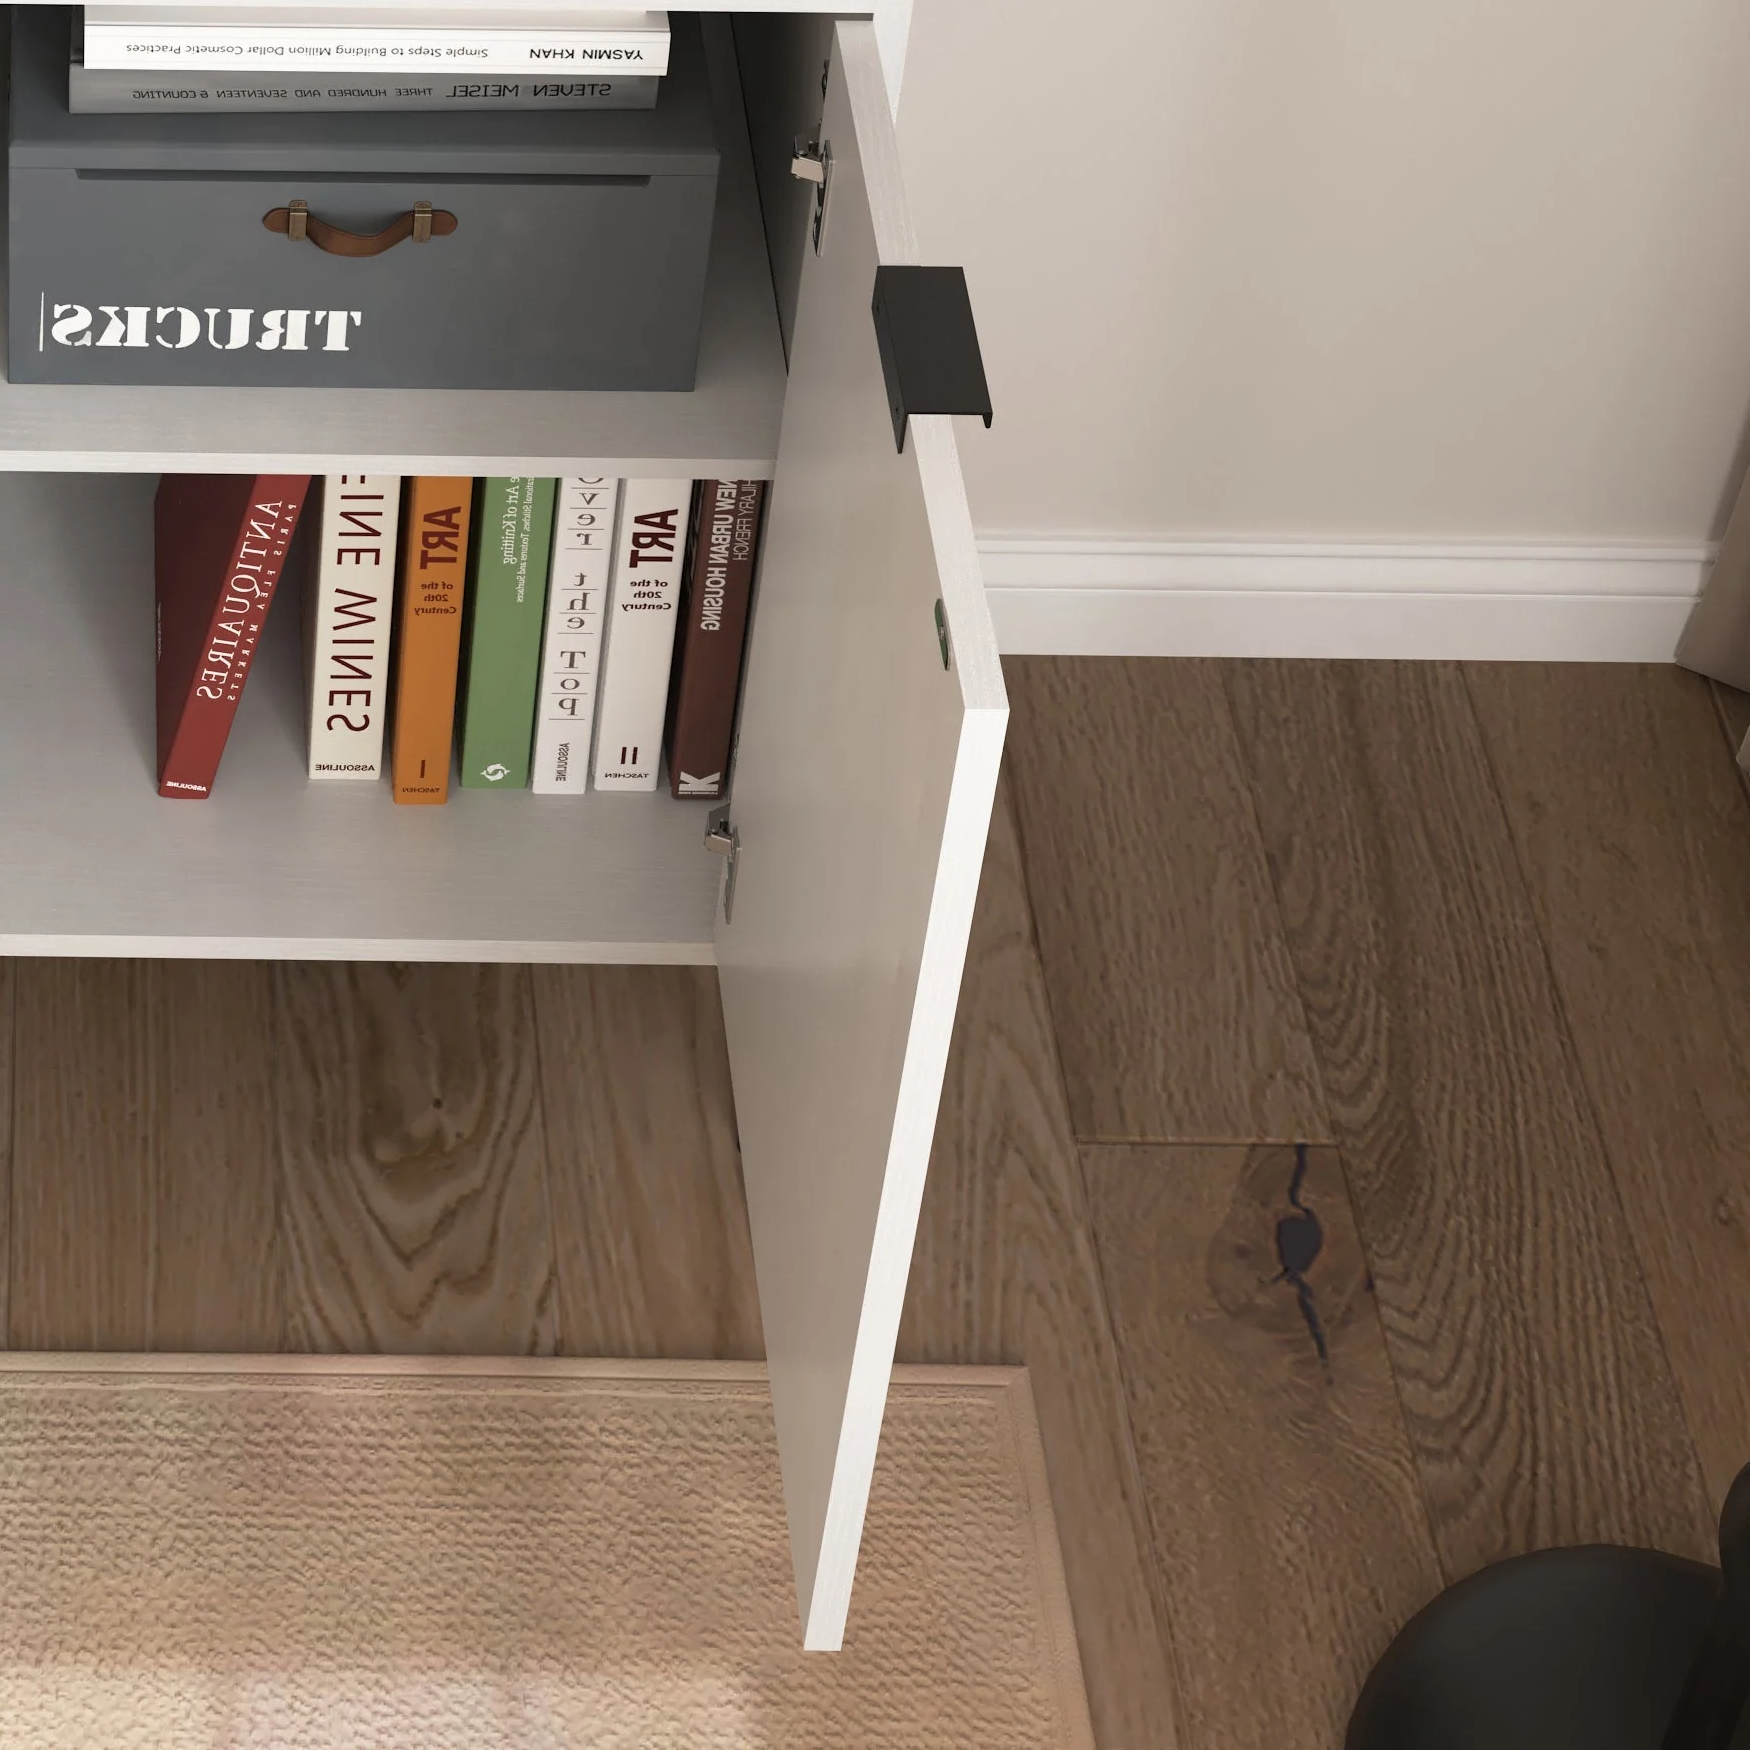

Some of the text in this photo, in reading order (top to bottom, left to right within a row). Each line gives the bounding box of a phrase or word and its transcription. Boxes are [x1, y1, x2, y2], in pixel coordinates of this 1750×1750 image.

[126, 44, 489, 58] Simple Steps to Building Million Dollar Cosmetic Practices
[529, 48, 644, 60] YASMIN KHAN
